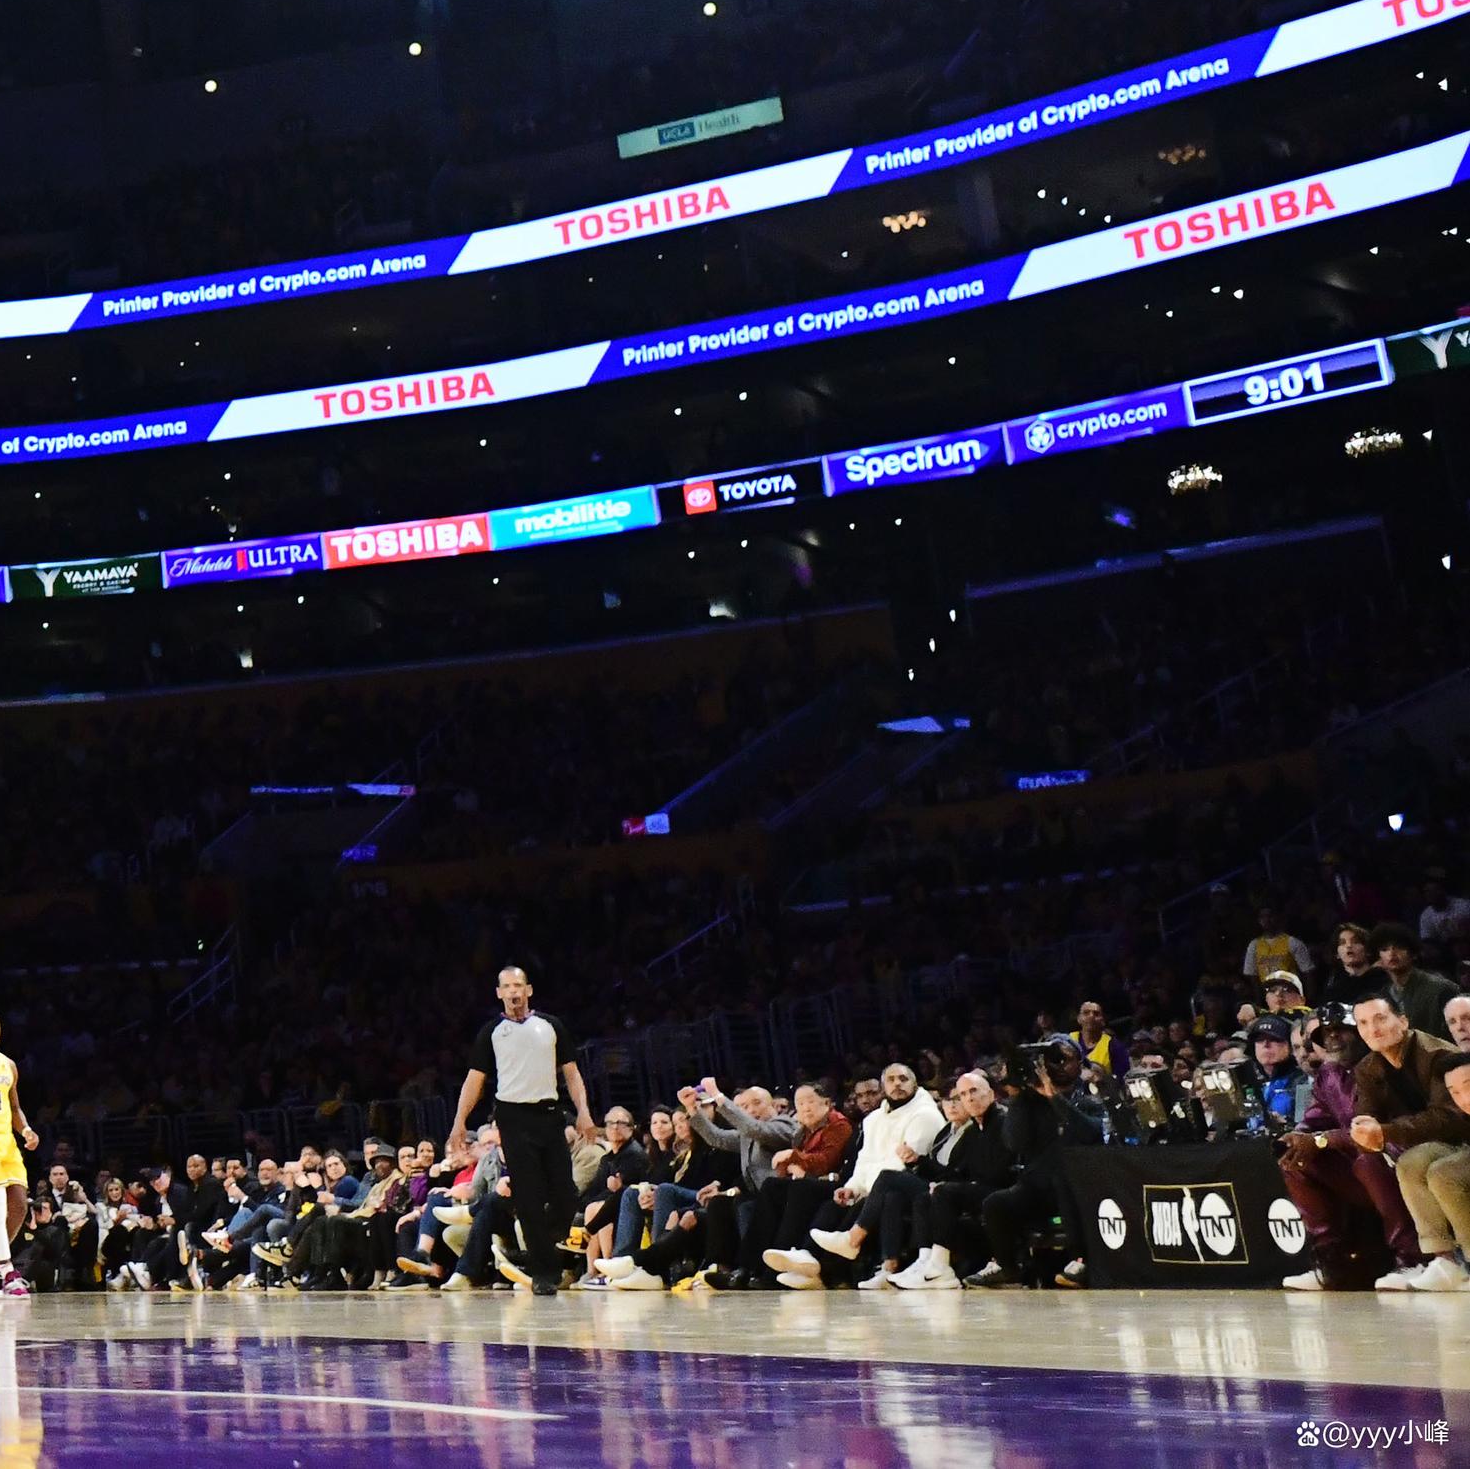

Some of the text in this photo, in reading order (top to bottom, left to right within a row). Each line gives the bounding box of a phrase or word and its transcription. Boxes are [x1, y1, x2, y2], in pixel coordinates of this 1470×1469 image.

[554, 187, 729, 244] TOSHIBA
[1124, 182, 1335, 258] TOSHIBA
[314, 372, 494, 418] TOSHIBA
[1243, 362, 1327, 407] 9:01
[1056, 399, 1168, 441] crypto.com
[845, 436, 983, 486] Spectrum
[718, 473, 797, 501] TOYOTA
[515, 498, 631, 534] mobilitie
[170, 543, 319, 579] Michelob ULTRA
[330, 519, 484, 562] TOSHIBA
[1101, 1217, 1126, 1236] TNT
[1151, 1201, 1237, 1247] NBA TNT
[1268, 1218, 1306, 1239] TNT
